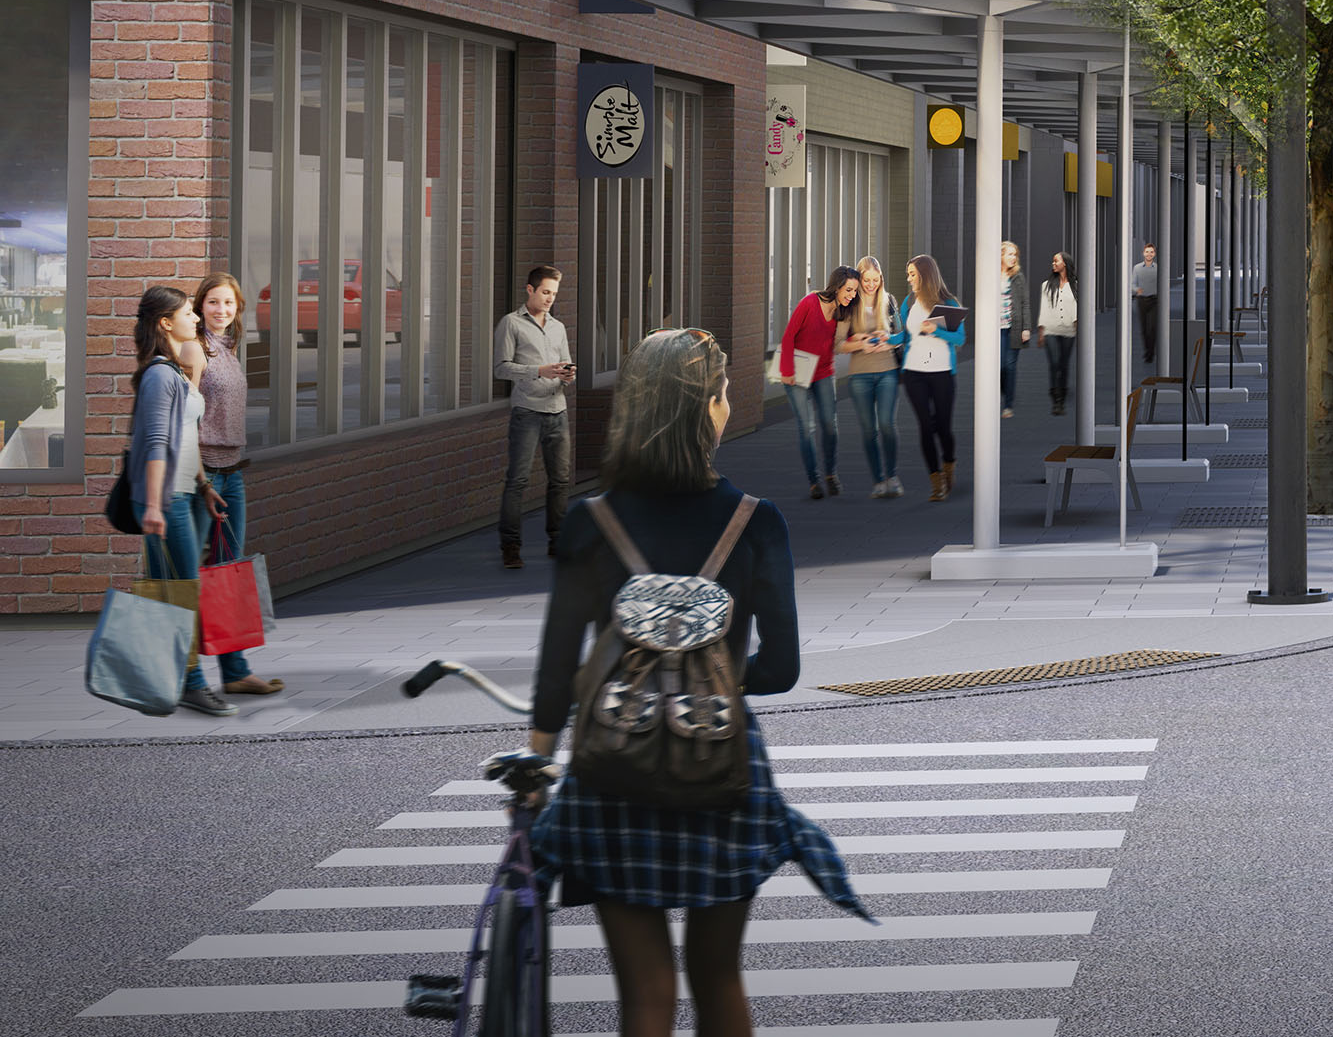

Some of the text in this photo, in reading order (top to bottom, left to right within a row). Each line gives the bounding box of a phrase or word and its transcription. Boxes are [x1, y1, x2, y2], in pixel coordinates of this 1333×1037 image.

[593, 95, 625, 159] Simple
[614, 79, 640, 148] Malt
[767, 121, 784, 155] Candy
